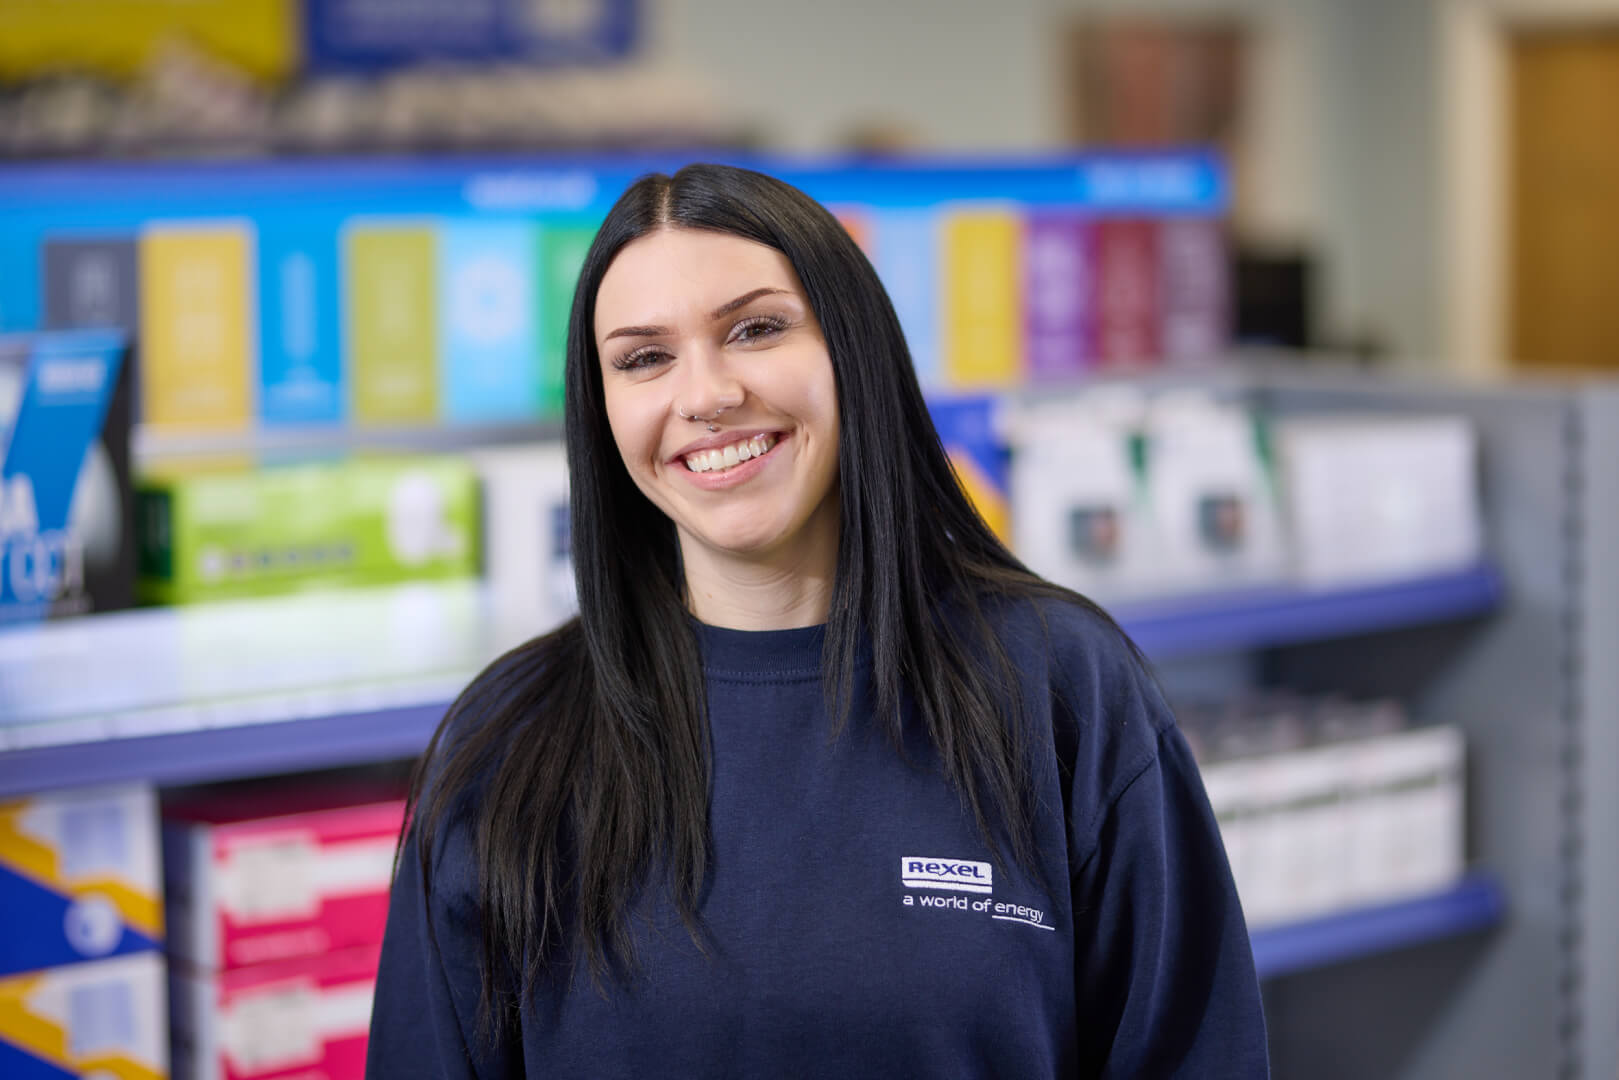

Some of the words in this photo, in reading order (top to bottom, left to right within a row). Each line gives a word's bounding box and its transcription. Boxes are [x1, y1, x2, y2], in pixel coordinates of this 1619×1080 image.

[903, 894, 914, 906] a
[919, 895, 968, 910] world
[972, 898, 993, 912] of
[994, 902, 1044, 923] energy
